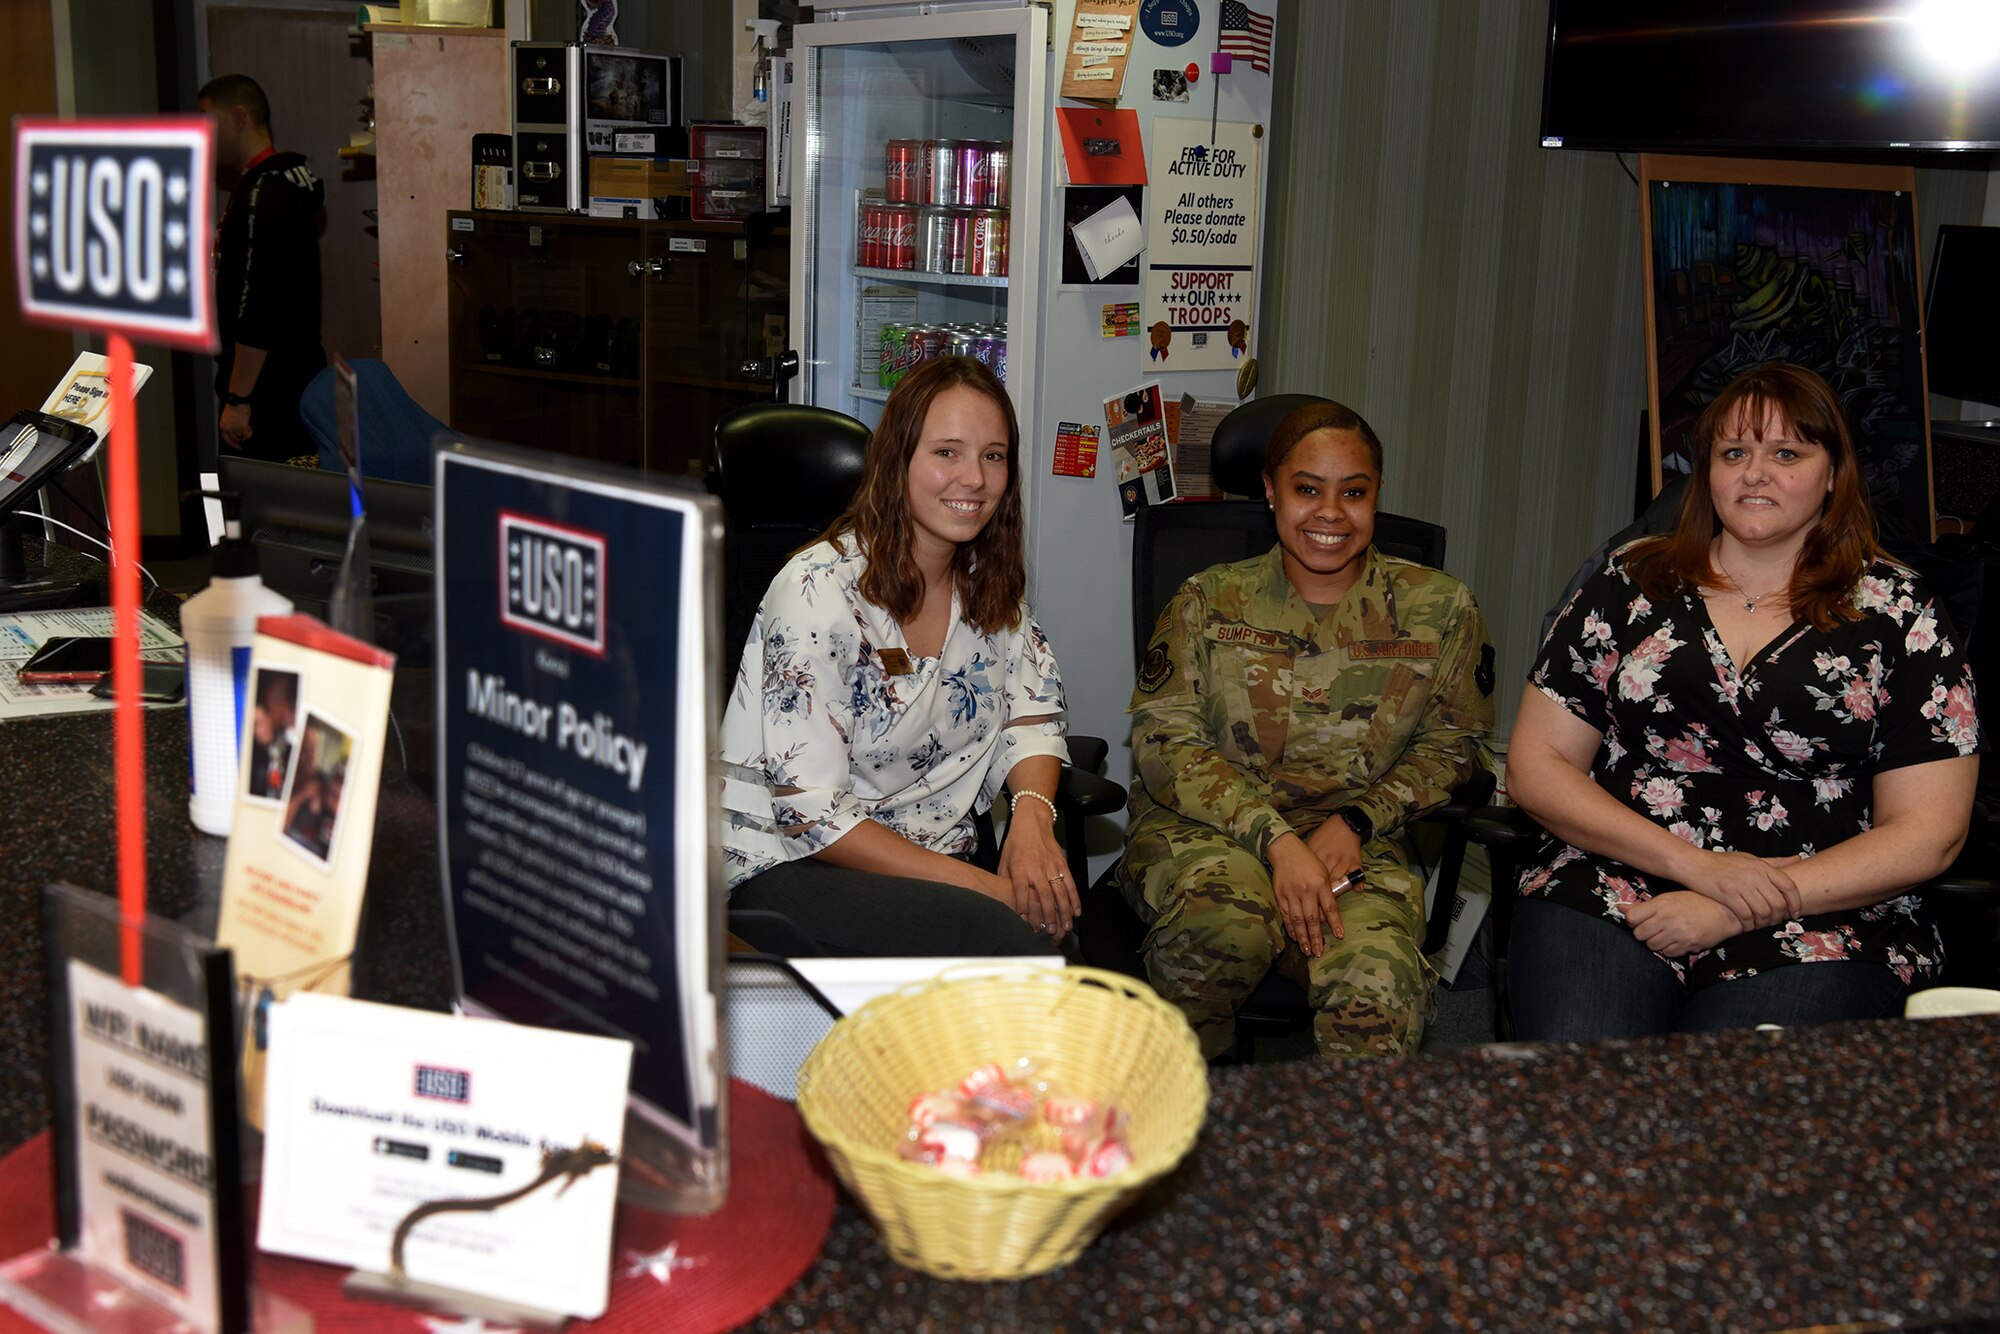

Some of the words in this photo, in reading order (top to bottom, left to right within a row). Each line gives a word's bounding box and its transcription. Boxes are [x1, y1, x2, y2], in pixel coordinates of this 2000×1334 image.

[1212, 149, 1235, 164] FOR
[1168, 160, 1211, 176] ACTIVE
[1213, 164, 1246, 178] DUTY
[1178, 193, 1195, 208] All
[1197, 193, 1234, 209] others
[1164, 209, 1202, 225] Please
[1205, 210, 1246, 226] donate
[53, 155, 163, 303] USO
[1171, 227, 1237, 246] $0.50/soda
[1171, 272, 1234, 290] SUPPORT
[1187, 290, 1216, 306] OUR
[1168, 307, 1231, 325] TROOPS
[62, 393, 81, 405] HERE
[71, 382, 91, 395] Please
[91, 386, 104, 398] Sign
[1111, 421, 1162, 448] CHECKERTAILS
[522, 535, 583, 628] USO
[1217, 626, 1277, 647] SUMPTER
[1377, 641, 1396, 657] AIR
[1398, 641, 1433, 657] FORCE
[467, 666, 552, 742] Minor
[557, 699, 648, 792] Policy
